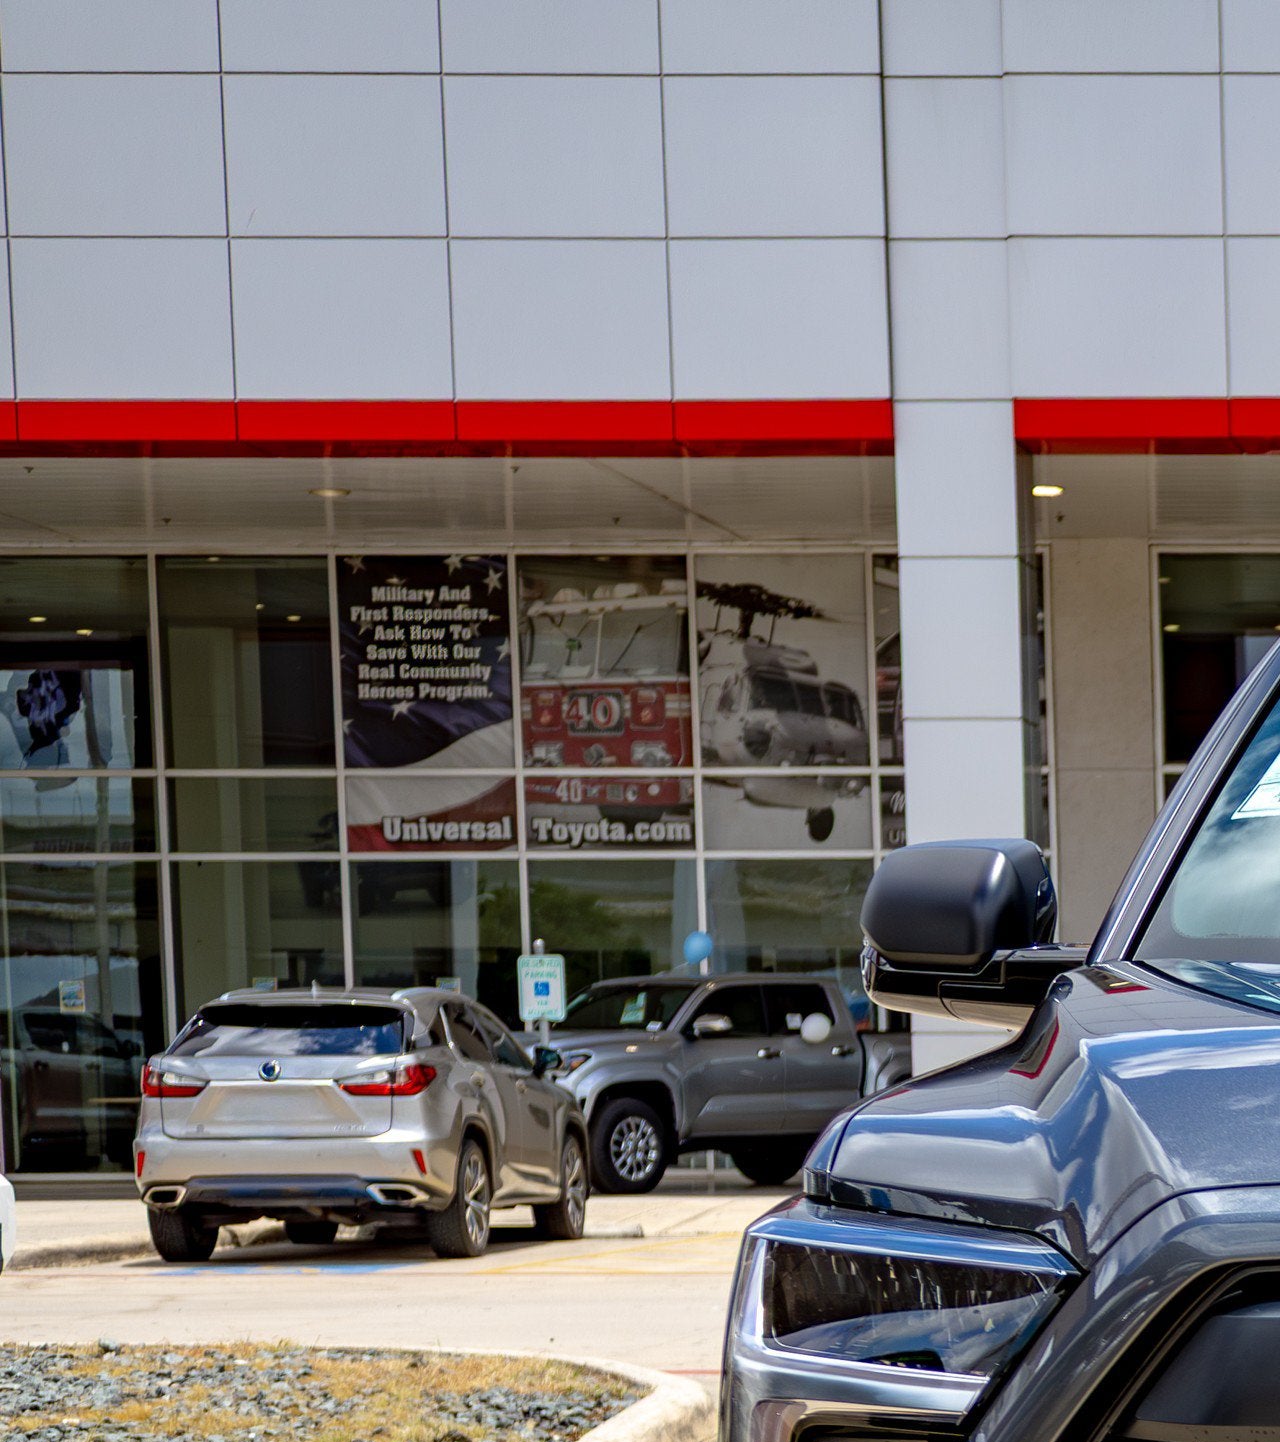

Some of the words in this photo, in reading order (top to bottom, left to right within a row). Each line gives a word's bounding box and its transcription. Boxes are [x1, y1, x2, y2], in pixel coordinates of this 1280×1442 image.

[370, 585, 436, 605] Military
[438, 585, 472, 601] And
[350, 605, 389, 622] First
[373, 624, 406, 641] Ask
[409, 624, 446, 641] How
[449, 624, 472, 640] To
[366, 644, 407, 660] Save
[410, 644, 449, 660] With
[452, 643, 482, 660] Our
[358, 663, 395, 680] Real
[399, 662, 492, 682] Community
[357, 682, 415, 700] Heroes
[418, 682, 494, 702] Program.
[563, 694, 620, 730] 40
[555, 778, 582, 803] 40
[382, 815, 513, 843] Universal
[531, 815, 692, 849] Toyota.com
